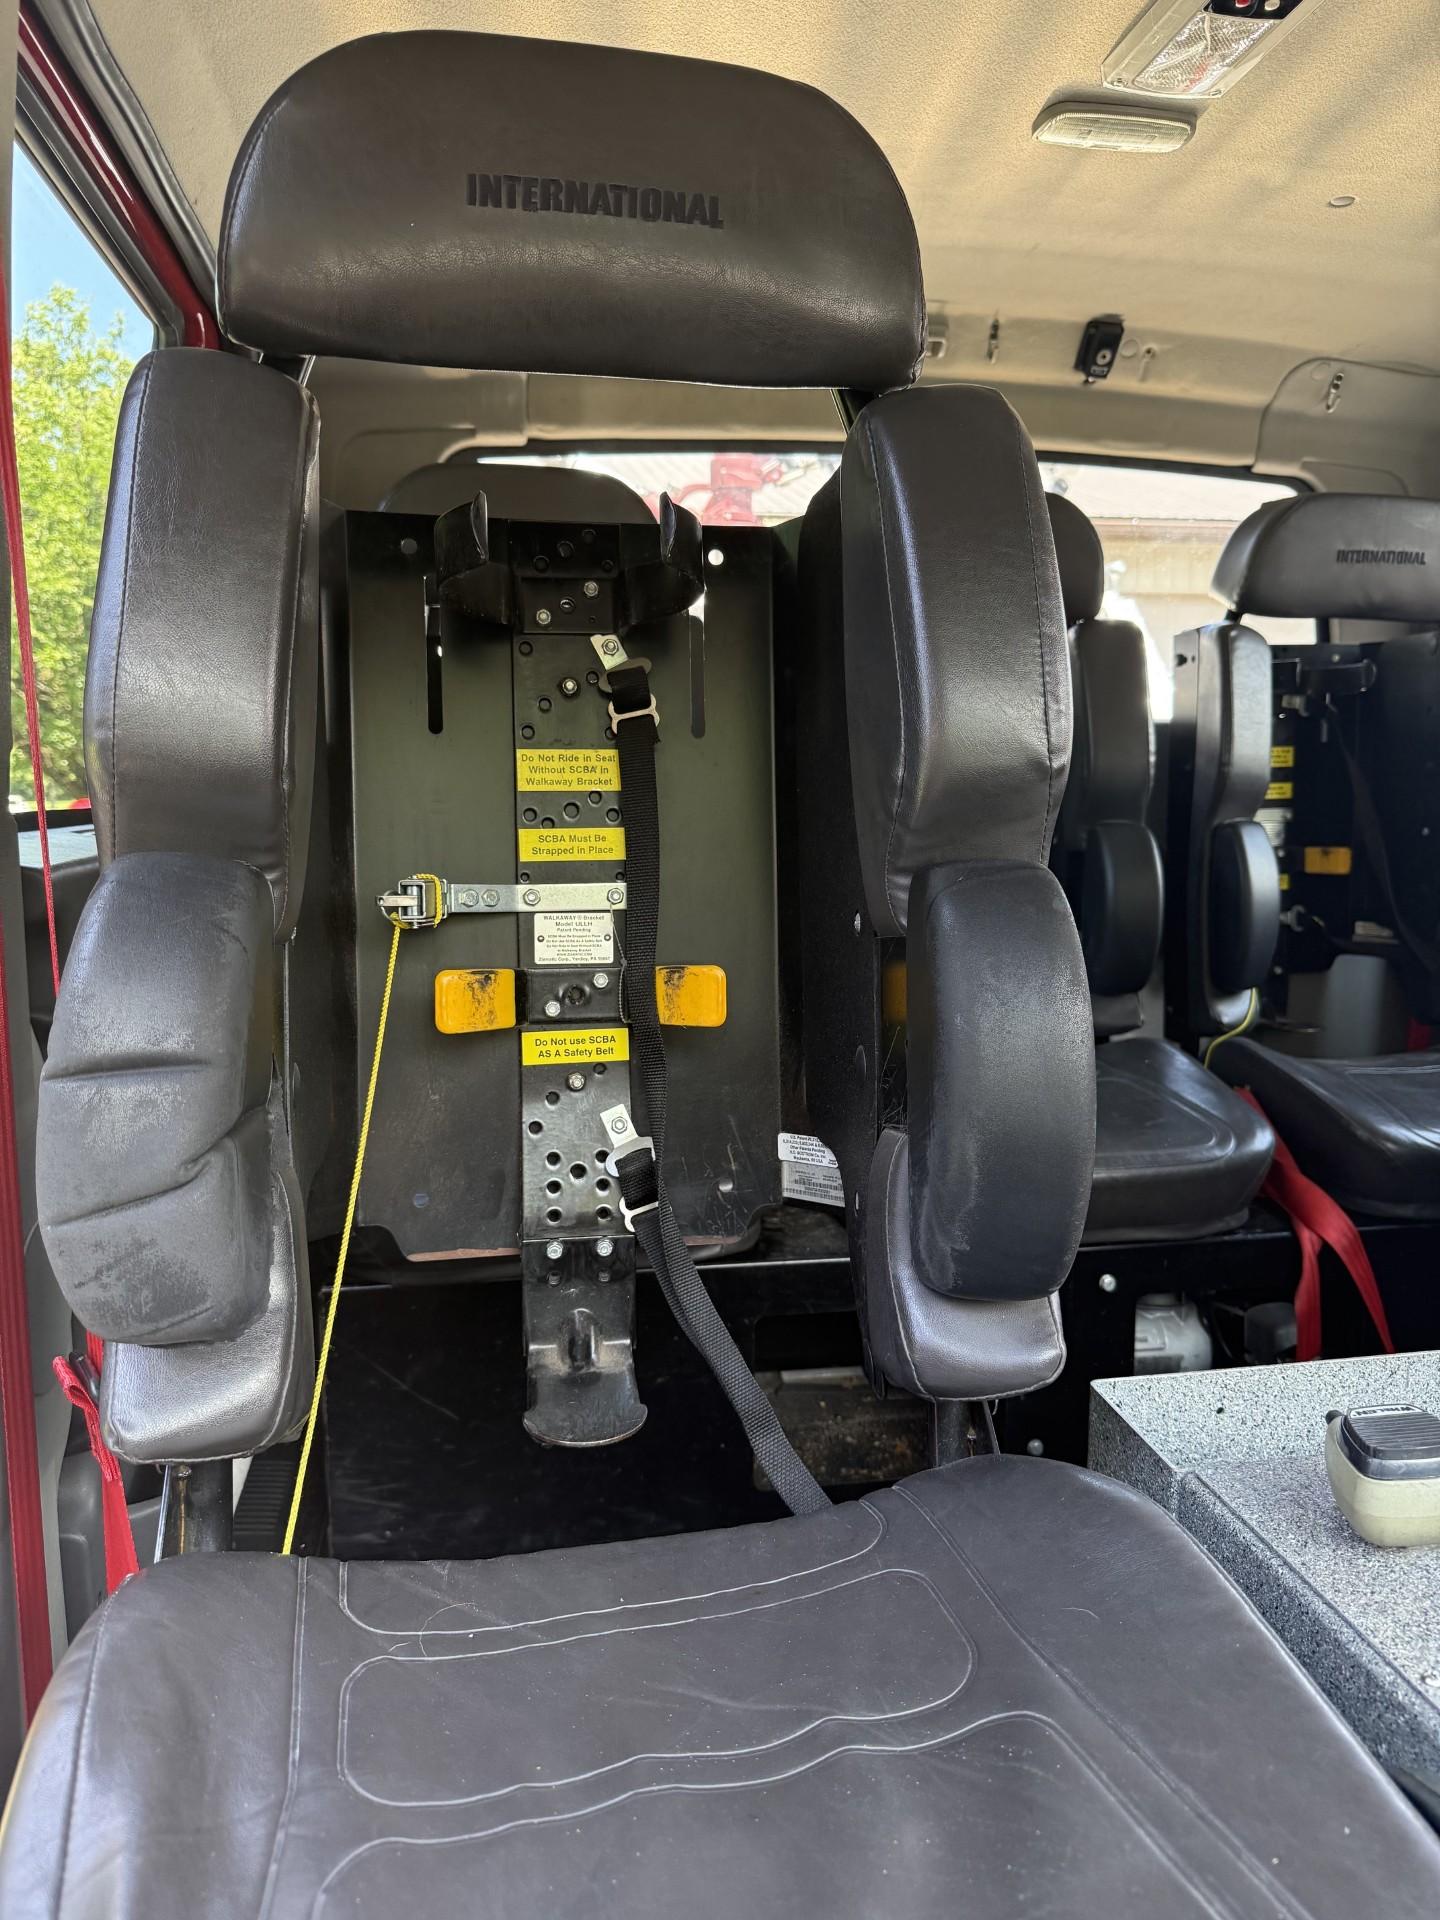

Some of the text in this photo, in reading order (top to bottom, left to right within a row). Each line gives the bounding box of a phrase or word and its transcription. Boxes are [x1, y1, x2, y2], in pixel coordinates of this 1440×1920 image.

[466, 173, 725, 229] INTERNATIONAL
[1336, 549, 1426, 566] INTERNATIONAL
[521, 753, 616, 762] Do Not Ride in Seat
[528, 765, 566, 774] Without
[569, 765, 597, 774] SCBA
[525, 777, 613, 787] Walkaway Bracket
[538, 834, 607, 843] SCBA Must Be
[531, 845, 614, 856] Strapped in Place
[535, 1035, 616, 1047] Do Not use SCBA
[538, 1047, 614, 1058] AS A Safety Belt
